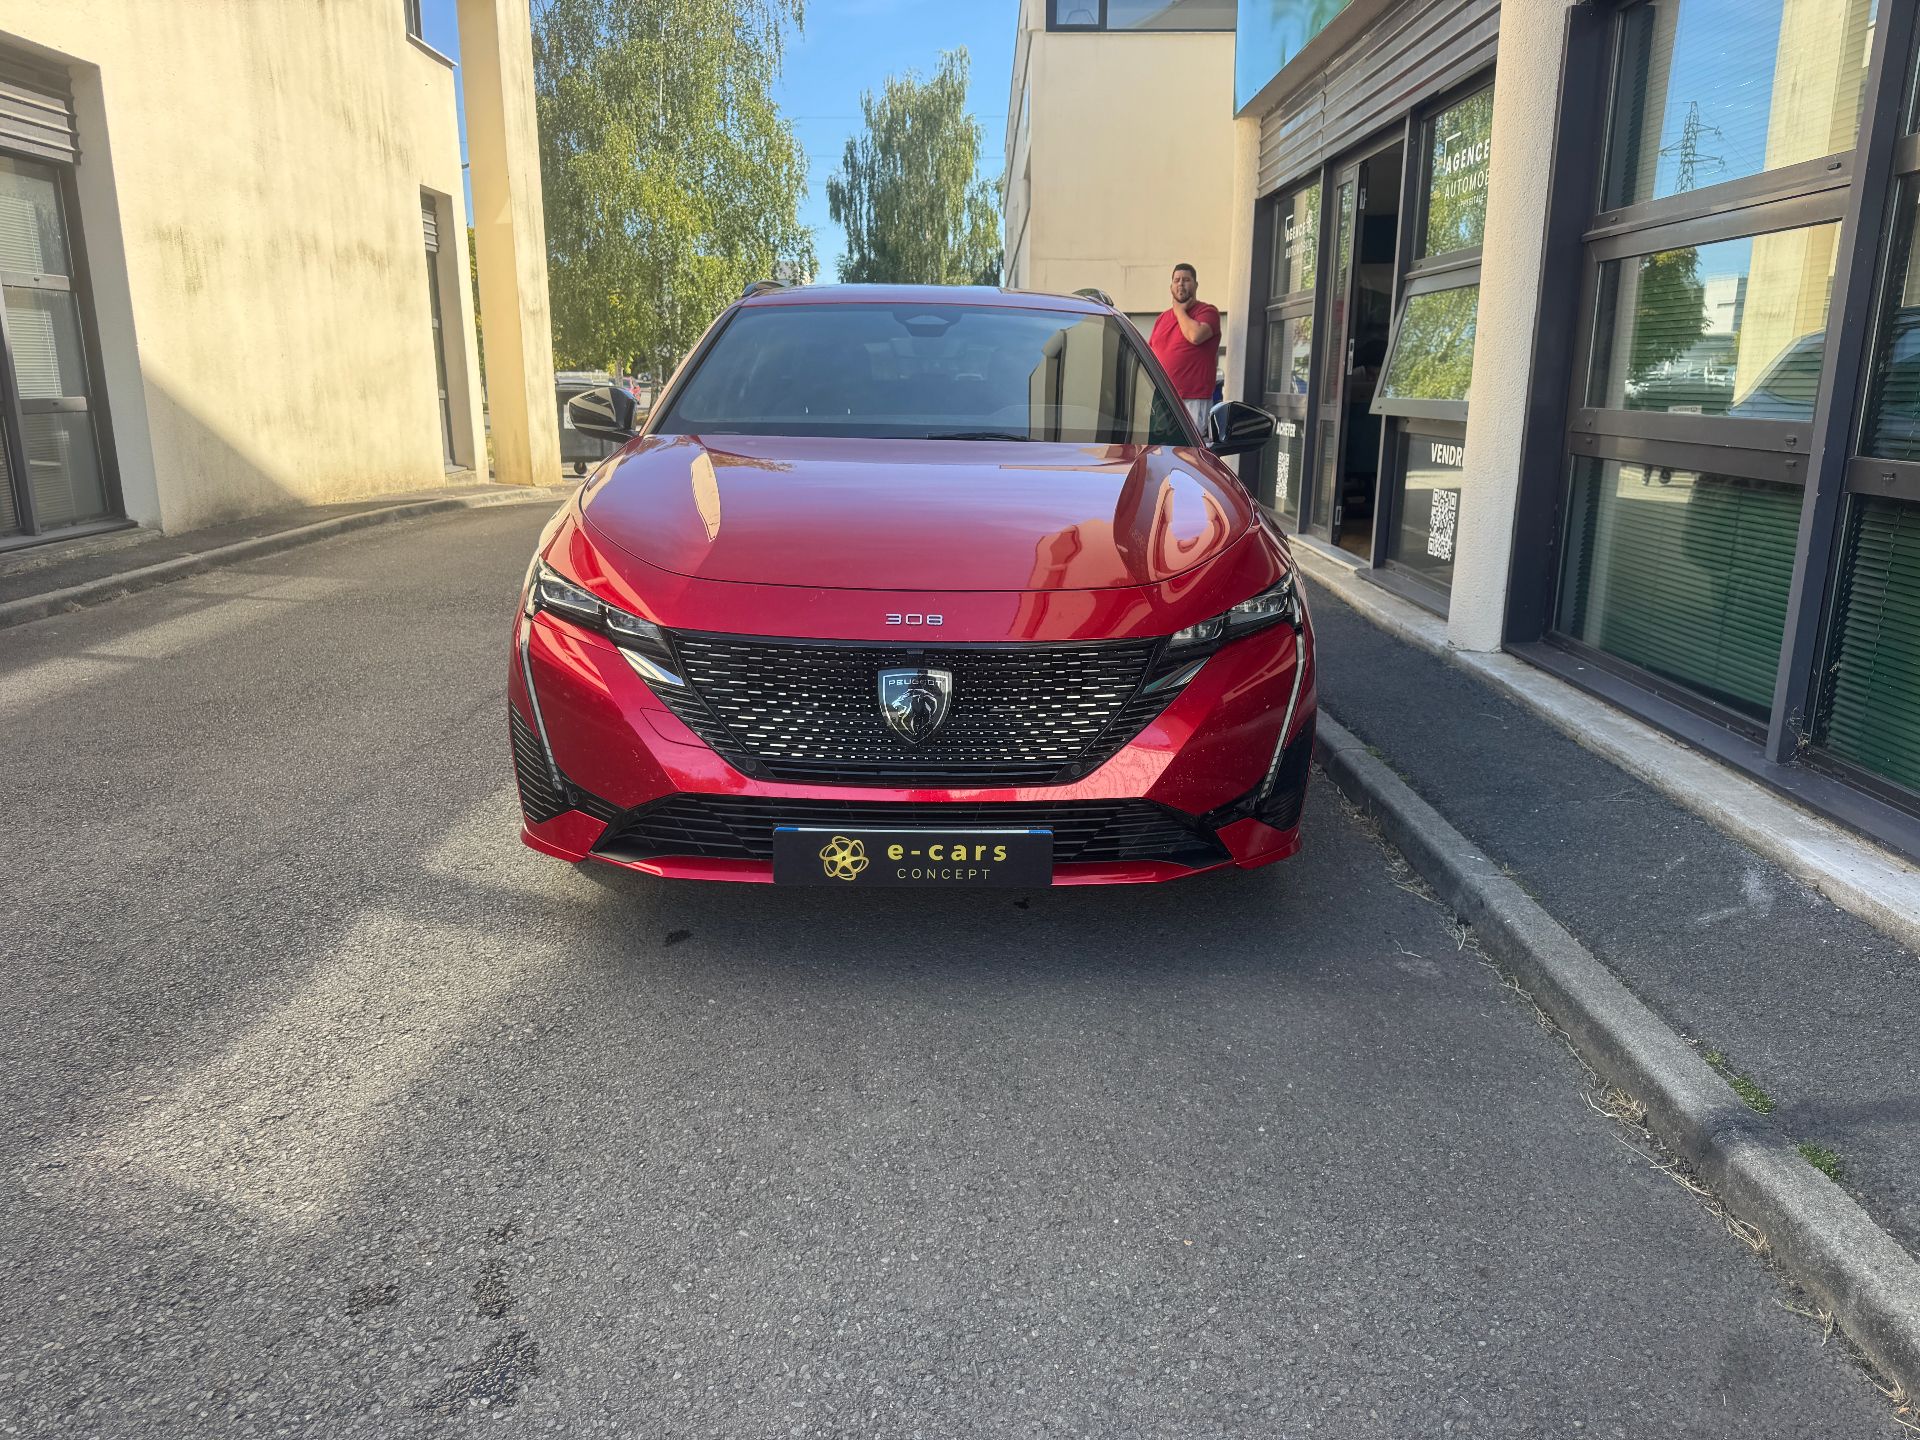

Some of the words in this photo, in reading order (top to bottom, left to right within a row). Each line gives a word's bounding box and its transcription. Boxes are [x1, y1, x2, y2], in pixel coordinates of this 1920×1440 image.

[1445, 138, 1490, 175] AGENCE
[1431, 442, 1464, 467] VENDR
[885, 613, 943, 626] 308
[887, 843, 1007, 862] e-cars
[896, 868, 991, 880] CONCEPT
